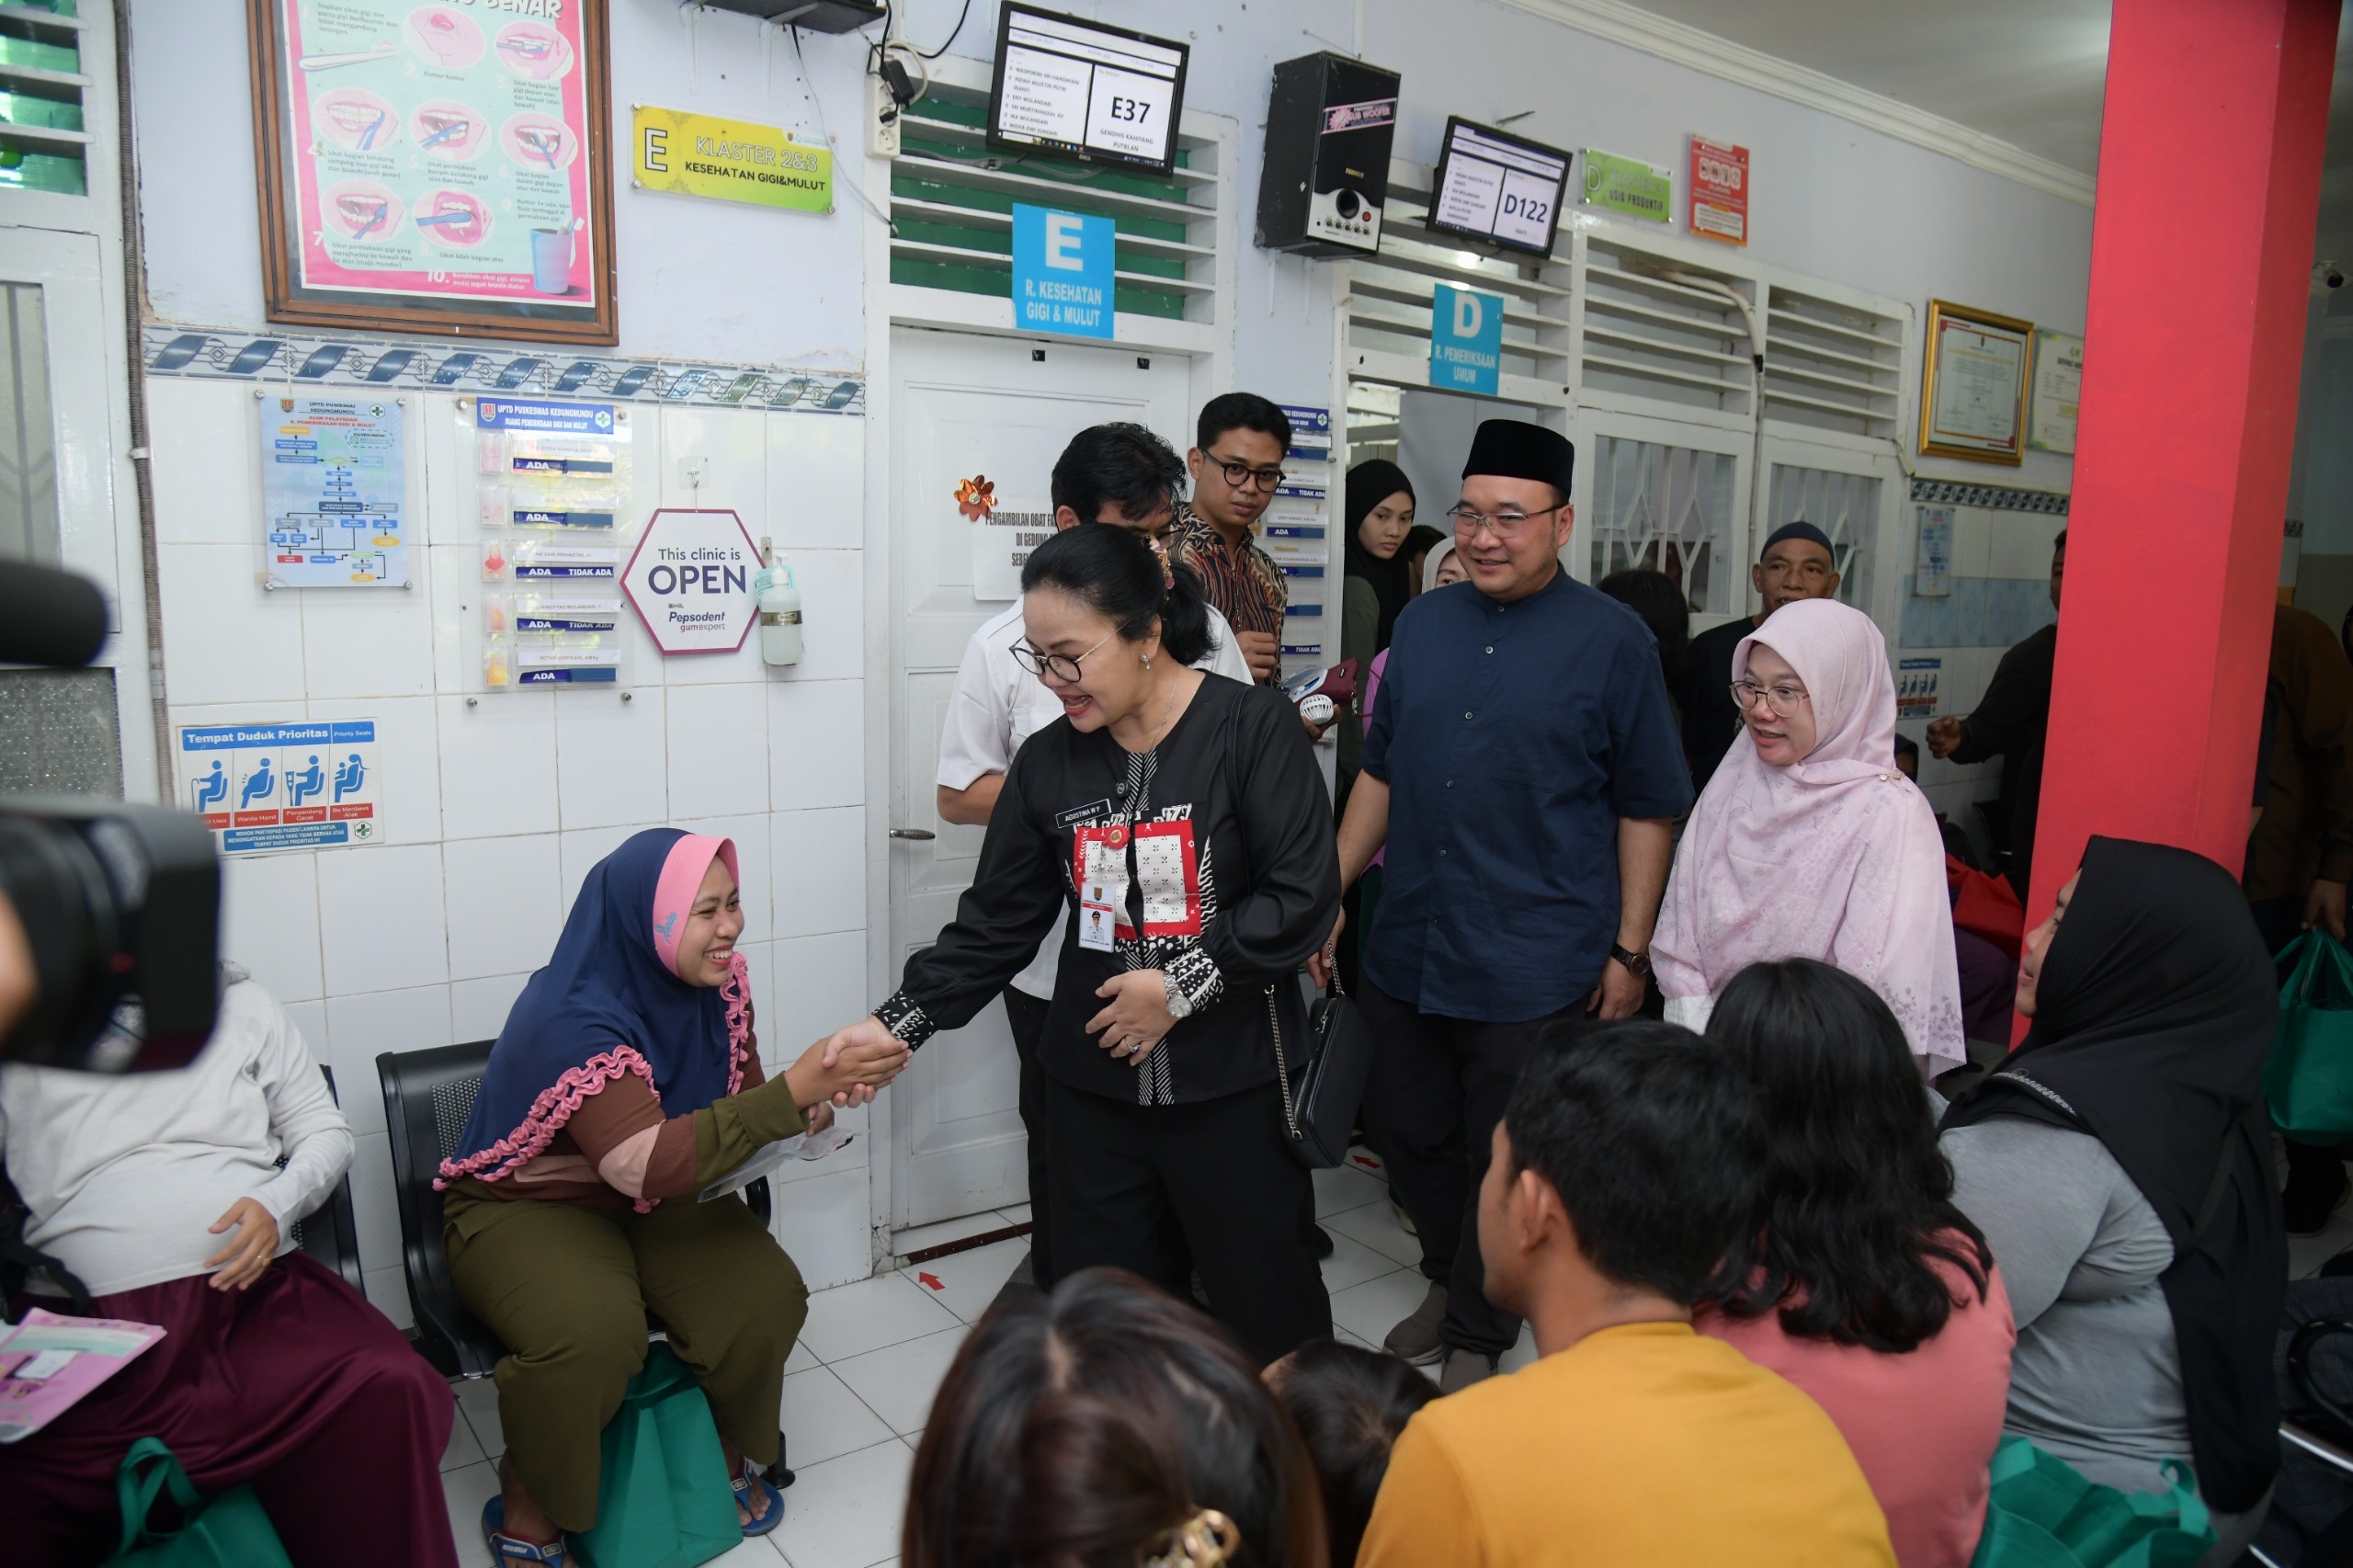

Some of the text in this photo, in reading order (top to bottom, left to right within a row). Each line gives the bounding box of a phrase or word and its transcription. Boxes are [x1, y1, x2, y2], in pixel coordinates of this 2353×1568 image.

[317, 2, 343, 12] Siapkan
[1111, 97, 1151, 123] E37
[645, 128, 667, 172] E
[697, 136, 776, 165] KLASTER
[781, 150, 817, 172] 2&3
[686, 162, 825, 191] KESEHATAN GIGI&MULUT
[1587, 164, 1601, 191] D
[1504, 194, 1548, 223] D122
[1609, 189, 1664, 212] USIA PRODUKTIF
[1046, 213, 1083, 271] E
[427, 268, 449, 284] 10.
[1026, 279, 1101, 305] R. KESEHATAN
[1027, 301, 1100, 327] GIGI & MULUT
[1453, 290, 1483, 338] D
[1436, 345, 1496, 369] R. PEMERIKSAAN
[1454, 366, 1476, 383] UMUM
[497, 404, 594, 418] UPTD PUSKESMAS KEDUNGMUNDU
[526, 461, 550, 470] ADA
[526, 513, 550, 521] ADA
[1030, 513, 1046, 527] OBAT
[1017, 533, 1022, 546] DI
[658, 548, 740, 561] This clinic is
[648, 565, 745, 595] OPEN
[669, 611, 725, 624] Pepsodent
[680, 623, 725, 632] gumexpert
[187, 729, 328, 744] Tempat Duduk Prioritas
[1065, 809, 1090, 822] AGUSTINA
